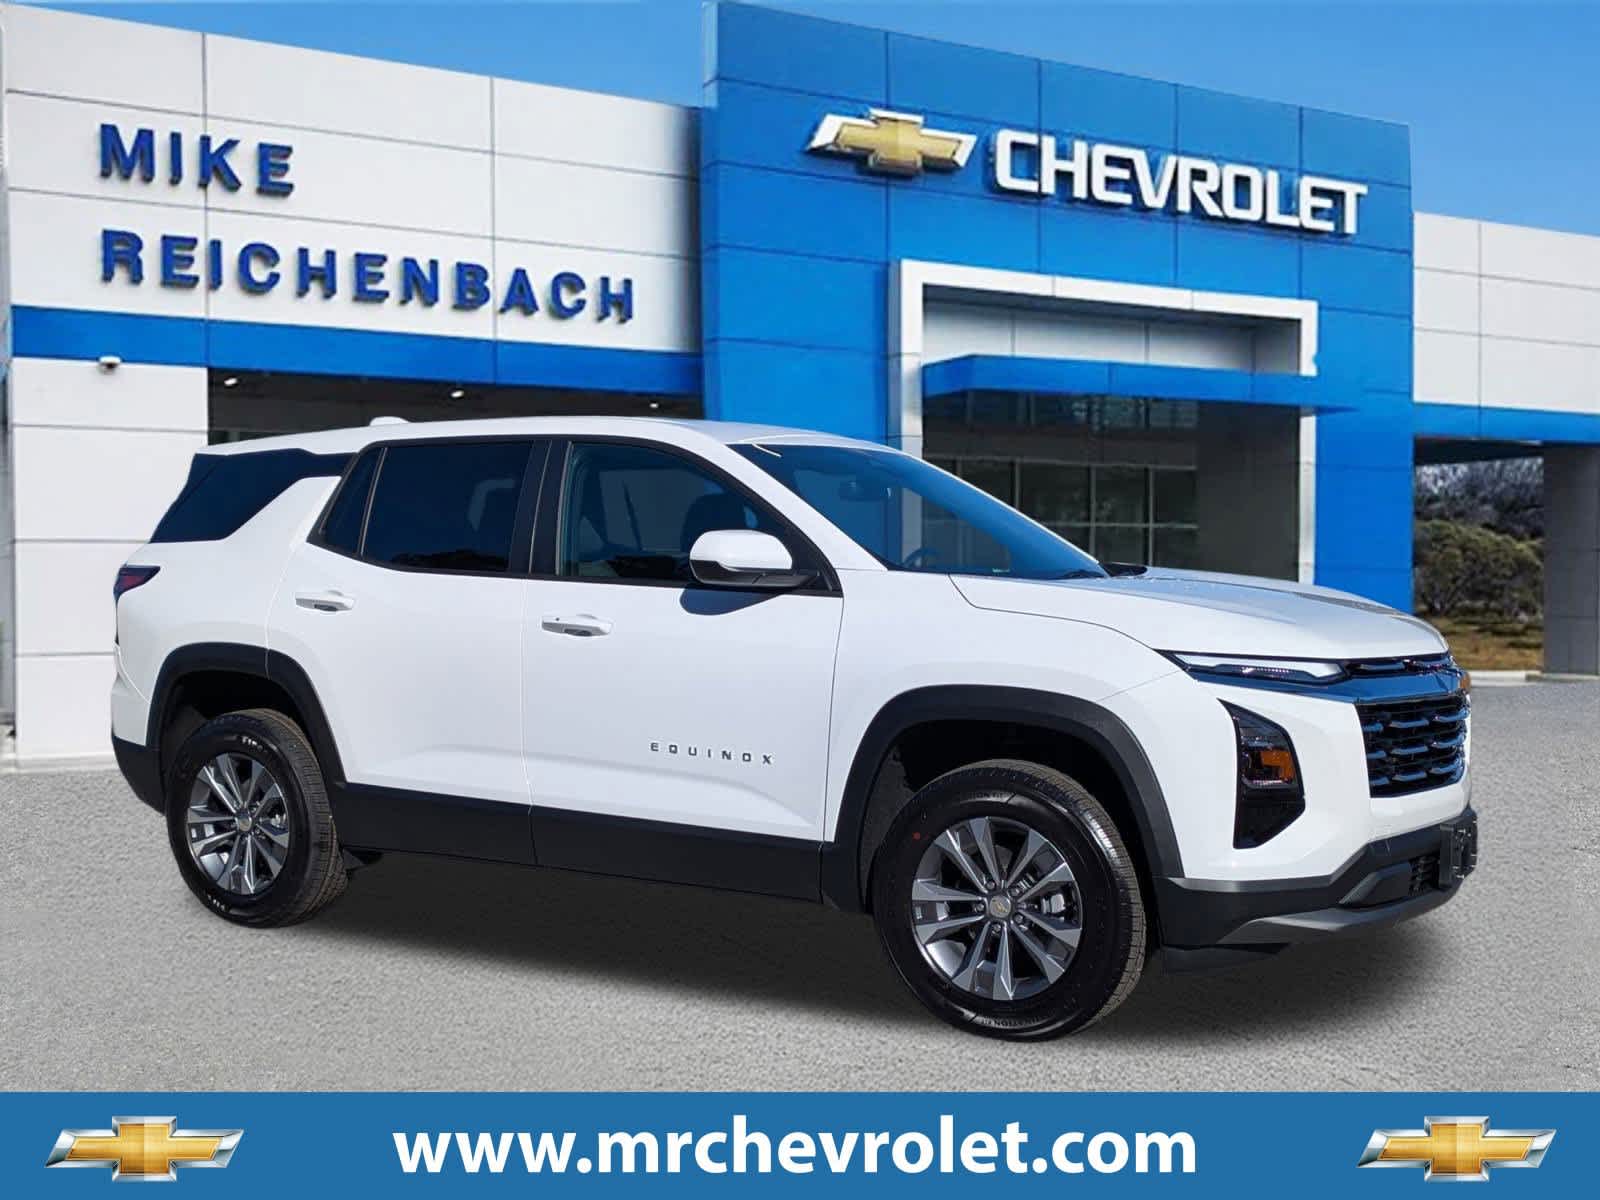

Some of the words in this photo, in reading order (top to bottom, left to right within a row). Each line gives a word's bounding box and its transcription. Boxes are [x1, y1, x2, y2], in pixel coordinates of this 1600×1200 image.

[100, 123, 295, 196] MIKE
[995, 129, 1368, 234] CHEVROLET
[101, 229, 634, 322] REICHENBACH
[650, 742, 772, 765] EQUINOX
